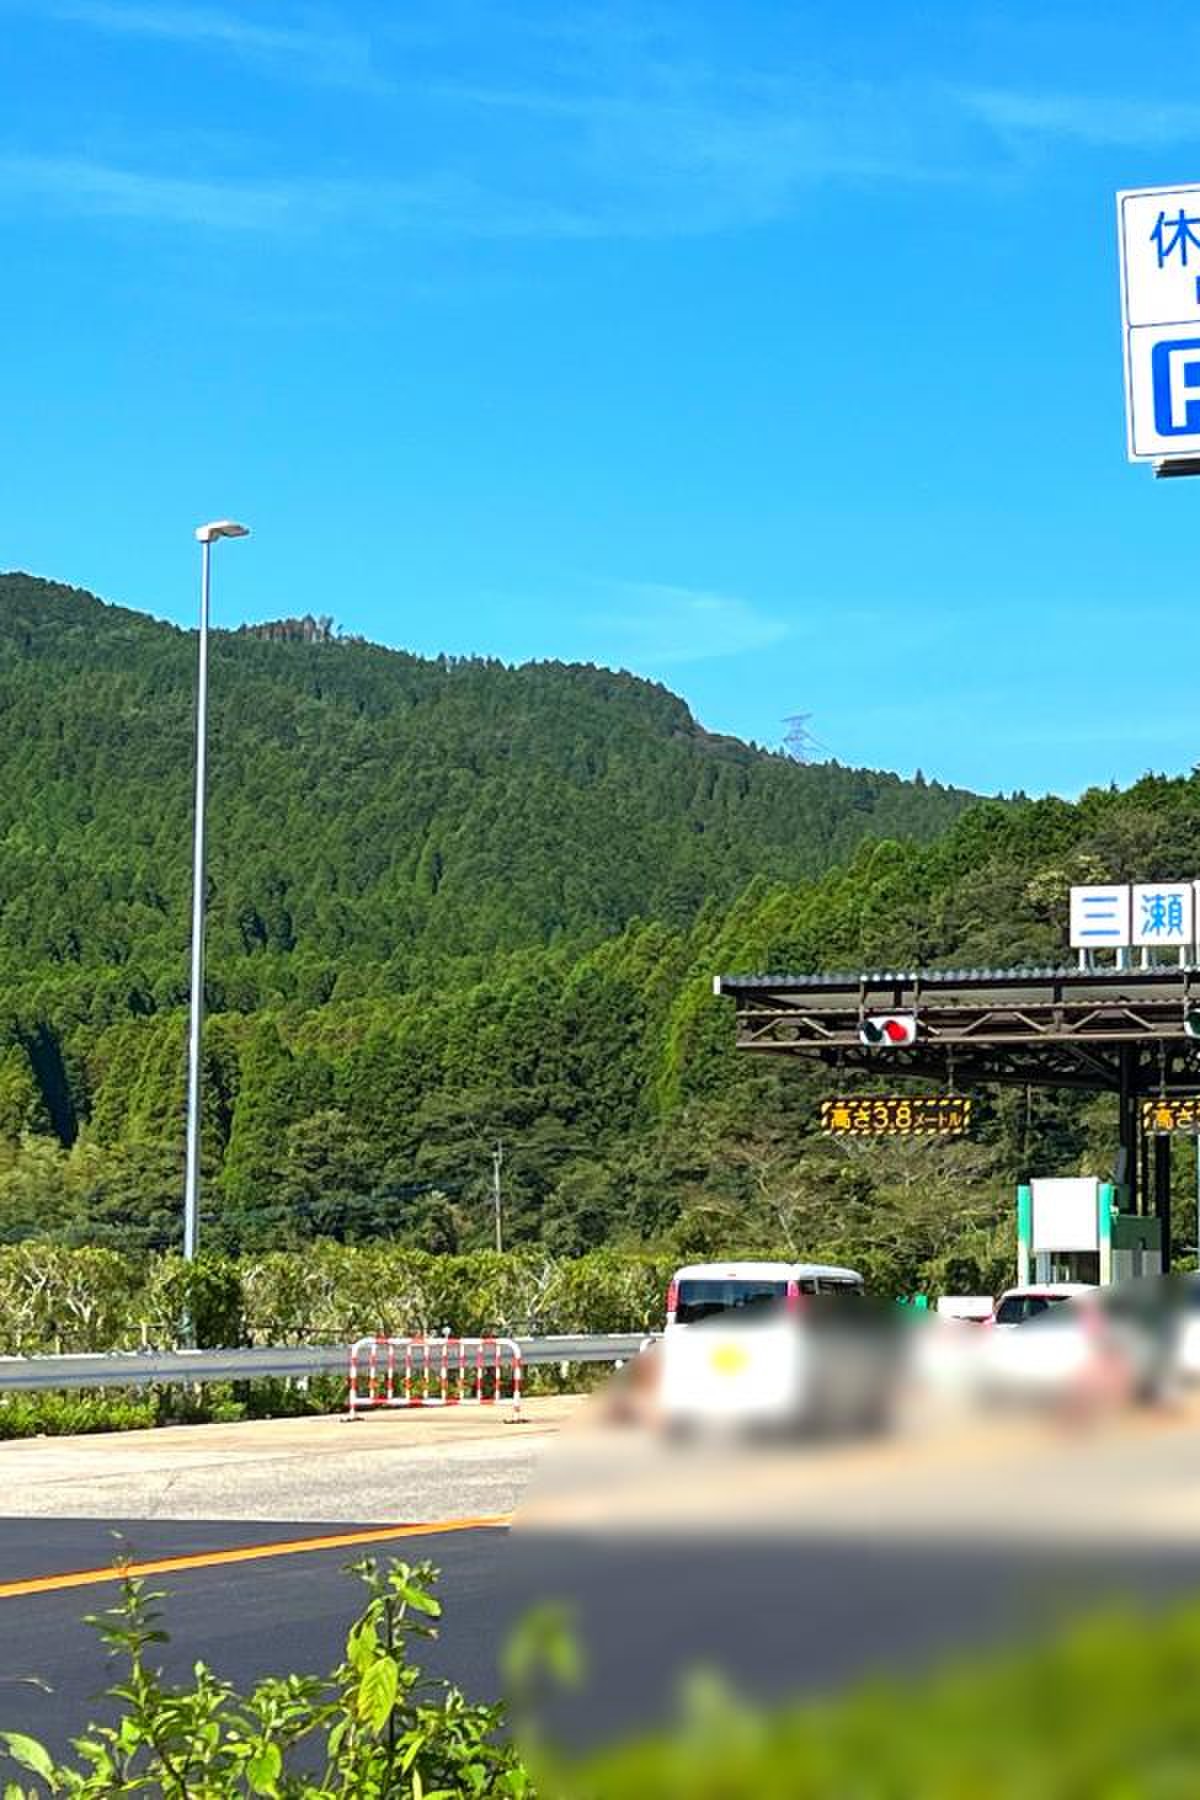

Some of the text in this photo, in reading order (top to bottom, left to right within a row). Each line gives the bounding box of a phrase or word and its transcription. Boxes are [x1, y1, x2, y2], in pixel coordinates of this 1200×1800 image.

[830, 1106, 963, 1130] 高さ3.8メートル
